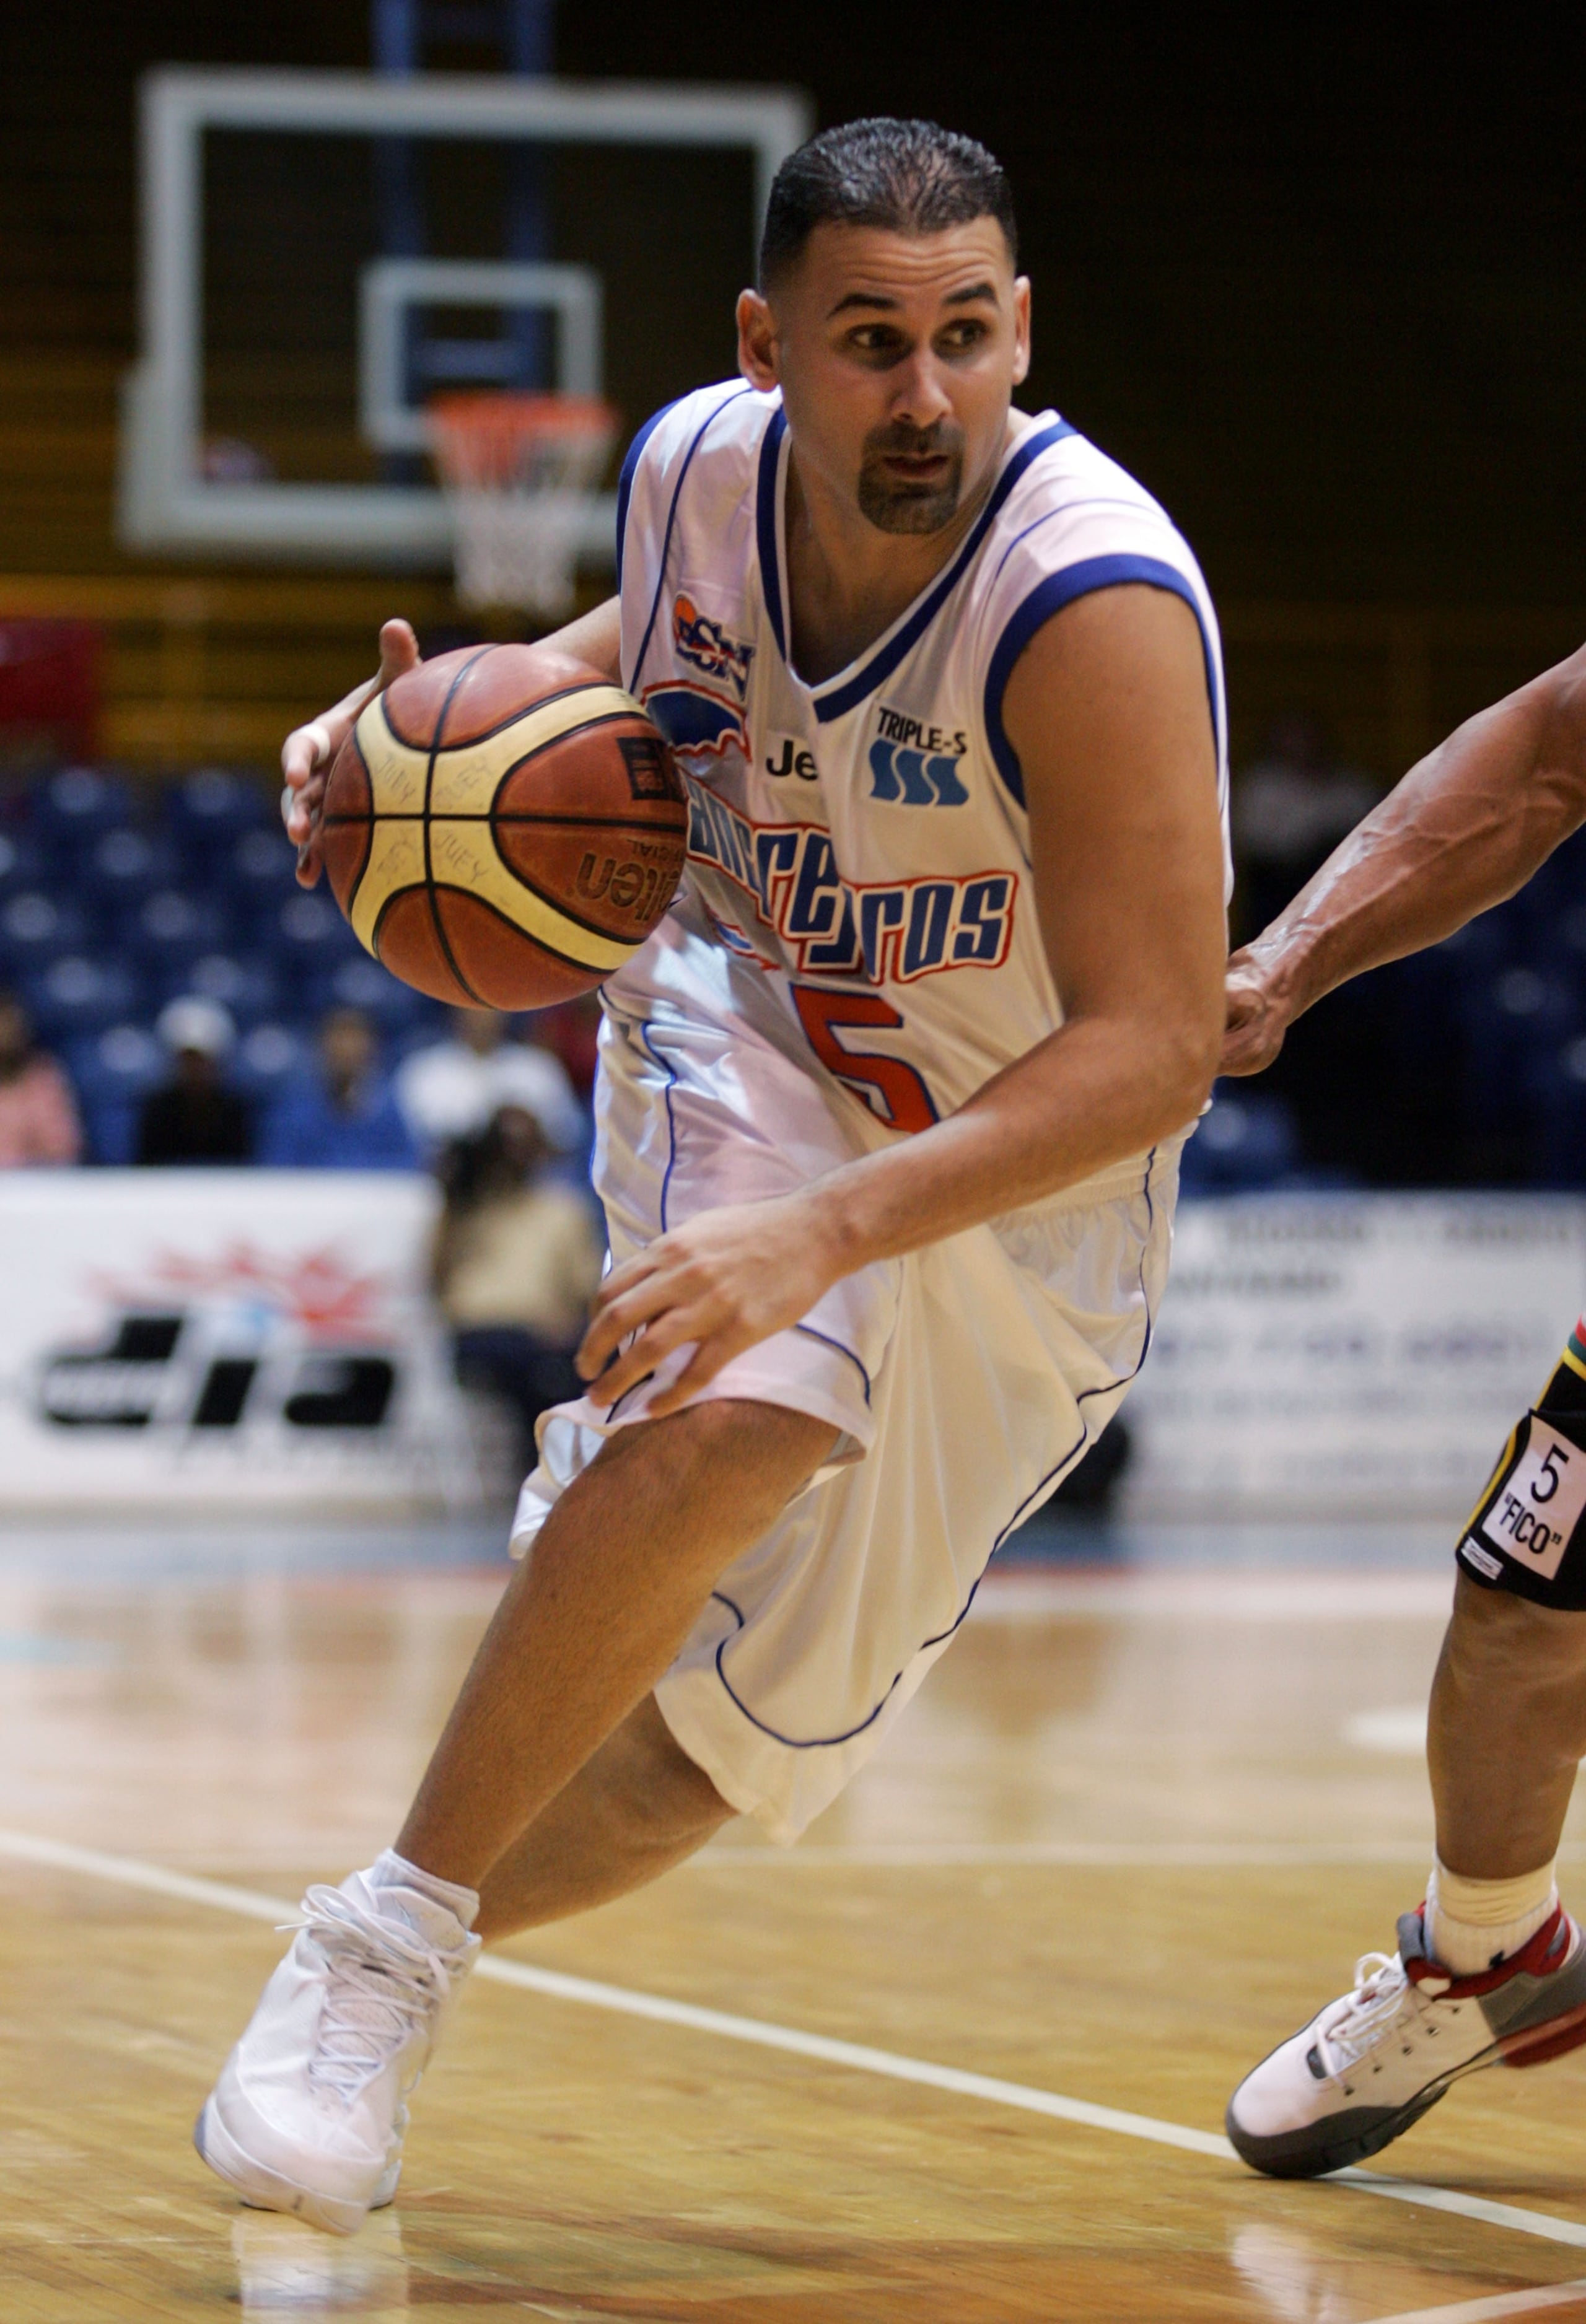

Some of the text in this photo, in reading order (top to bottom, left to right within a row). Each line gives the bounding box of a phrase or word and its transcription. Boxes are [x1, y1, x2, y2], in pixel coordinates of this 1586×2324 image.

[877, 706, 968, 755] TRIPLE-S
[766, 740, 819, 782] Je
[789, 981, 940, 1135] 5
[1531, 1444, 1570, 1503] 5
